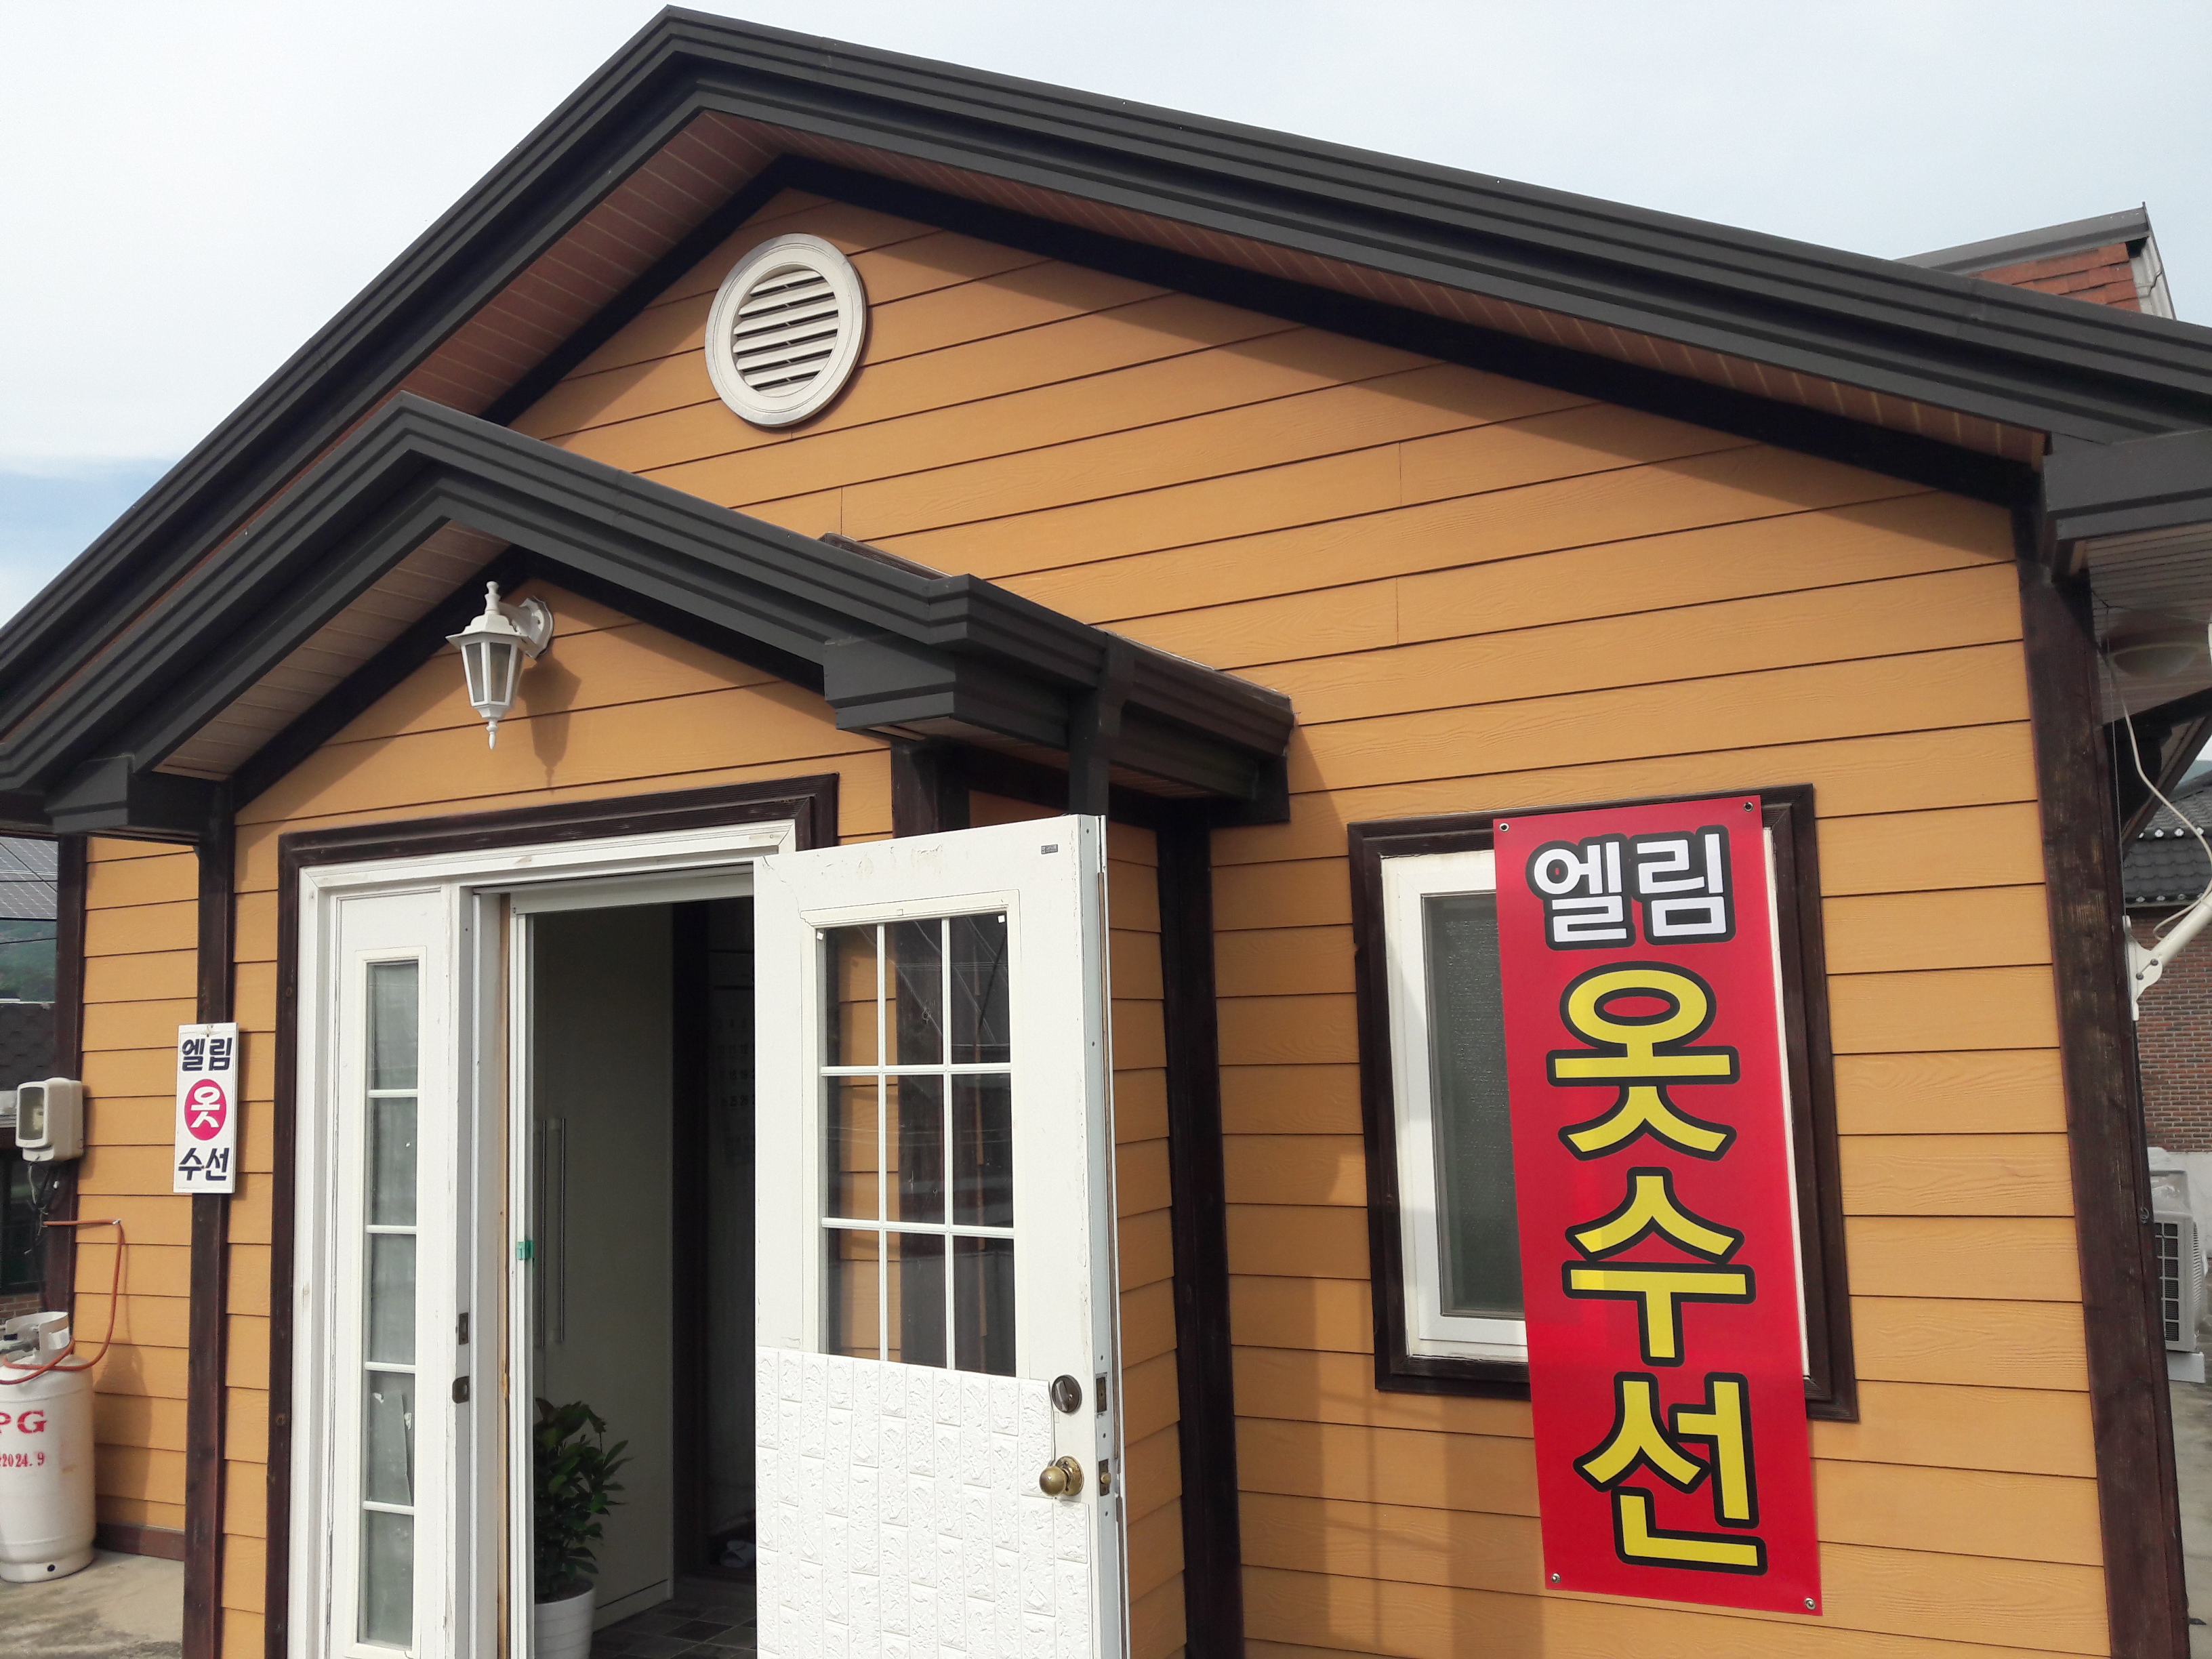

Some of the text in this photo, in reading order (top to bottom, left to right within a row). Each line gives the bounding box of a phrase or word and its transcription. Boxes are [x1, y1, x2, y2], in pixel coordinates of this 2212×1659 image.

[1526, 825, 1735, 950] 엘림
[182, 1037, 233, 1071] 엘림
[190, 1086, 222, 1129] 옷
[178, 1147, 230, 1181] 수선
